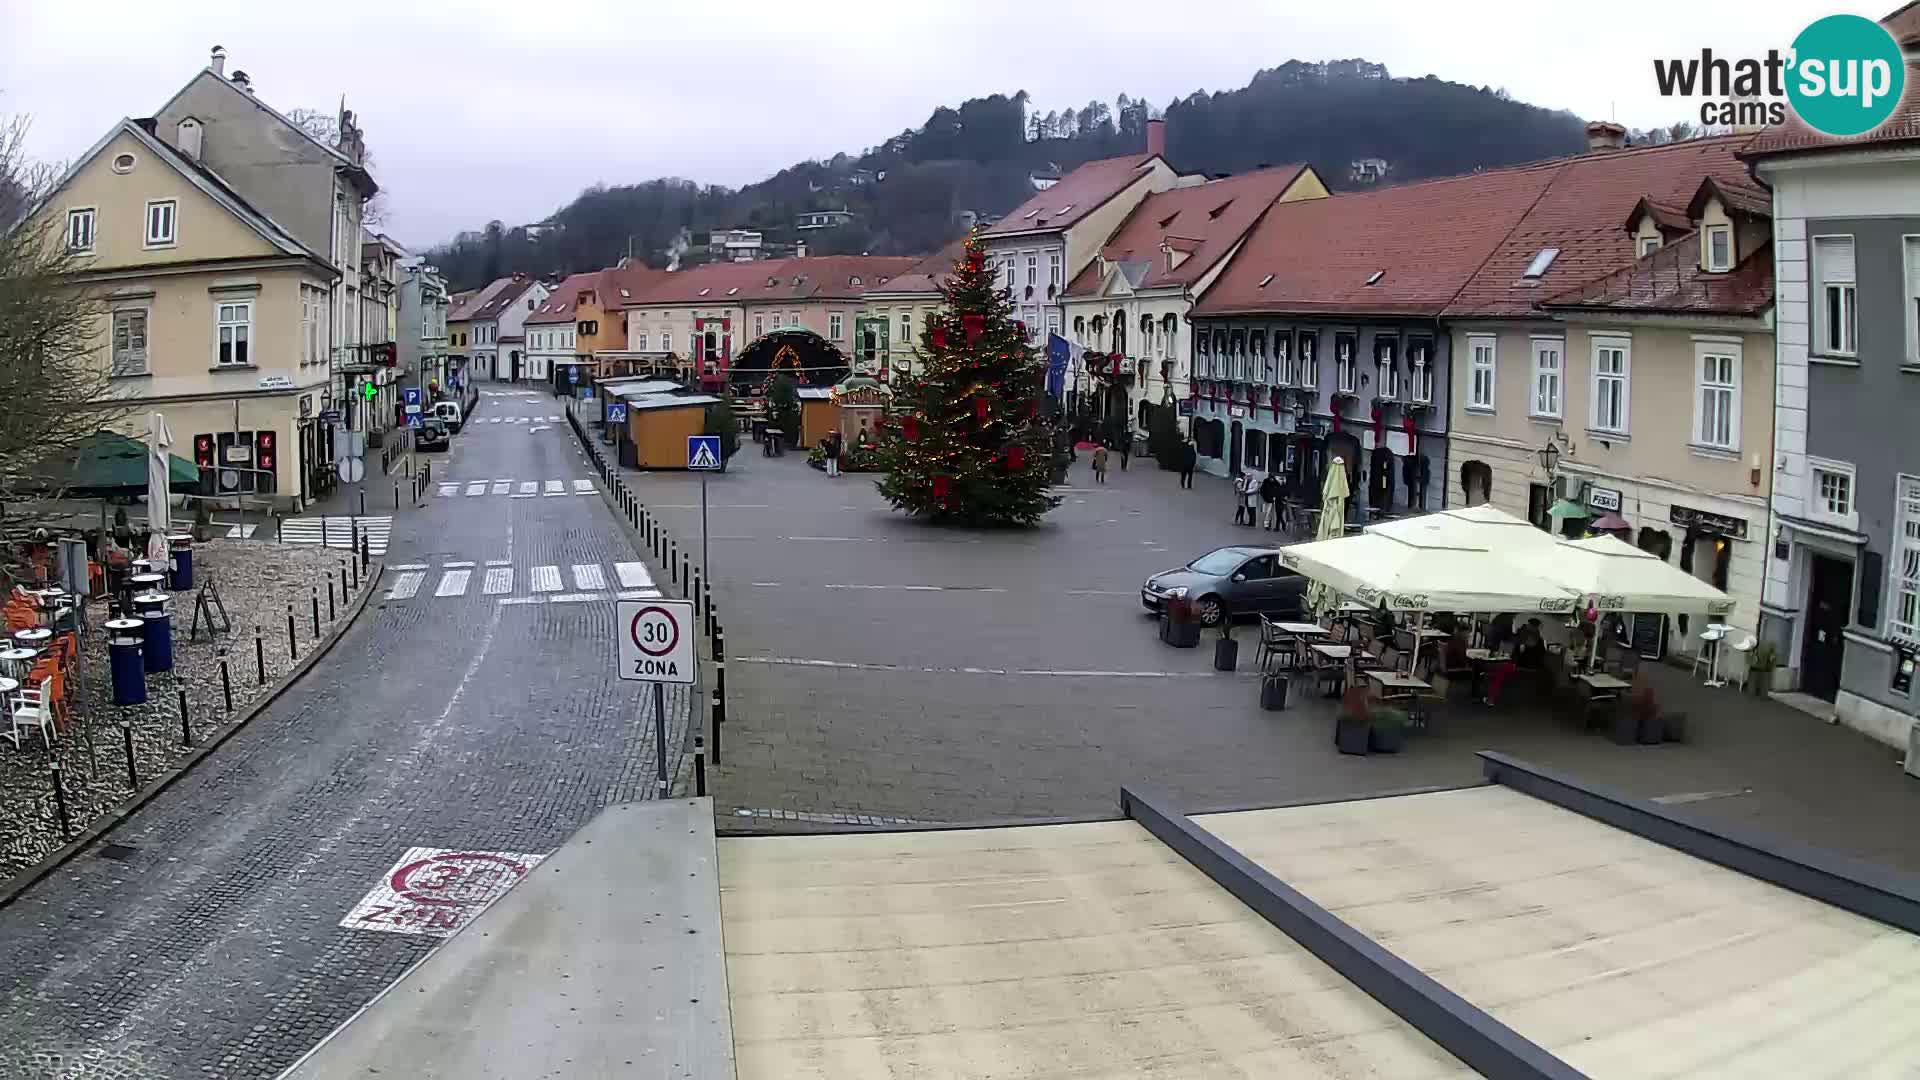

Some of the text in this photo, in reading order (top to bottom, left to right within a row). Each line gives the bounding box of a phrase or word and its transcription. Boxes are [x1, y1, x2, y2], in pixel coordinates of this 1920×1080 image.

[408, 391, 417, 403] P
[643, 622, 668, 644] 30
[634, 659, 679, 677] ZONA
